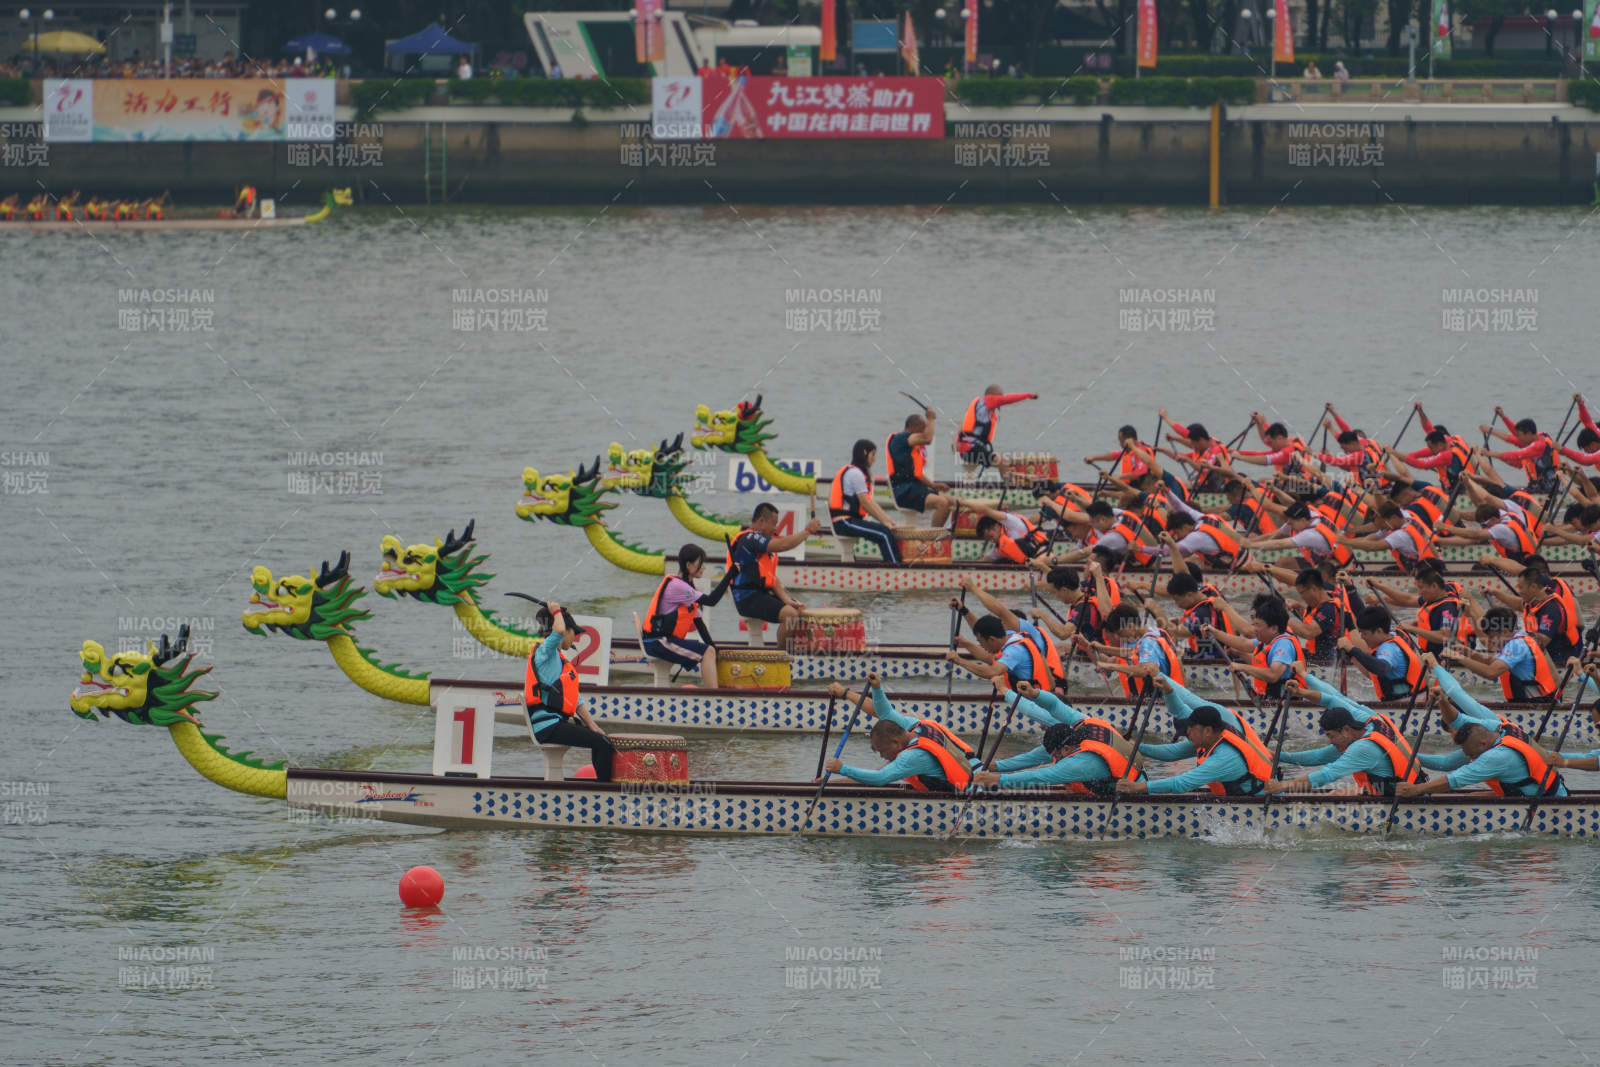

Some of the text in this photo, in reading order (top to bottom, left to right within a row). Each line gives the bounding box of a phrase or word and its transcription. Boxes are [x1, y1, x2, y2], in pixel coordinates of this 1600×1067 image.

[123, 87, 232, 116] 活力工行
[767, 112, 932, 132] 中国龙舟走向世界
[573, 625, 601, 675] 2
[453, 707, 476, 764] 1
